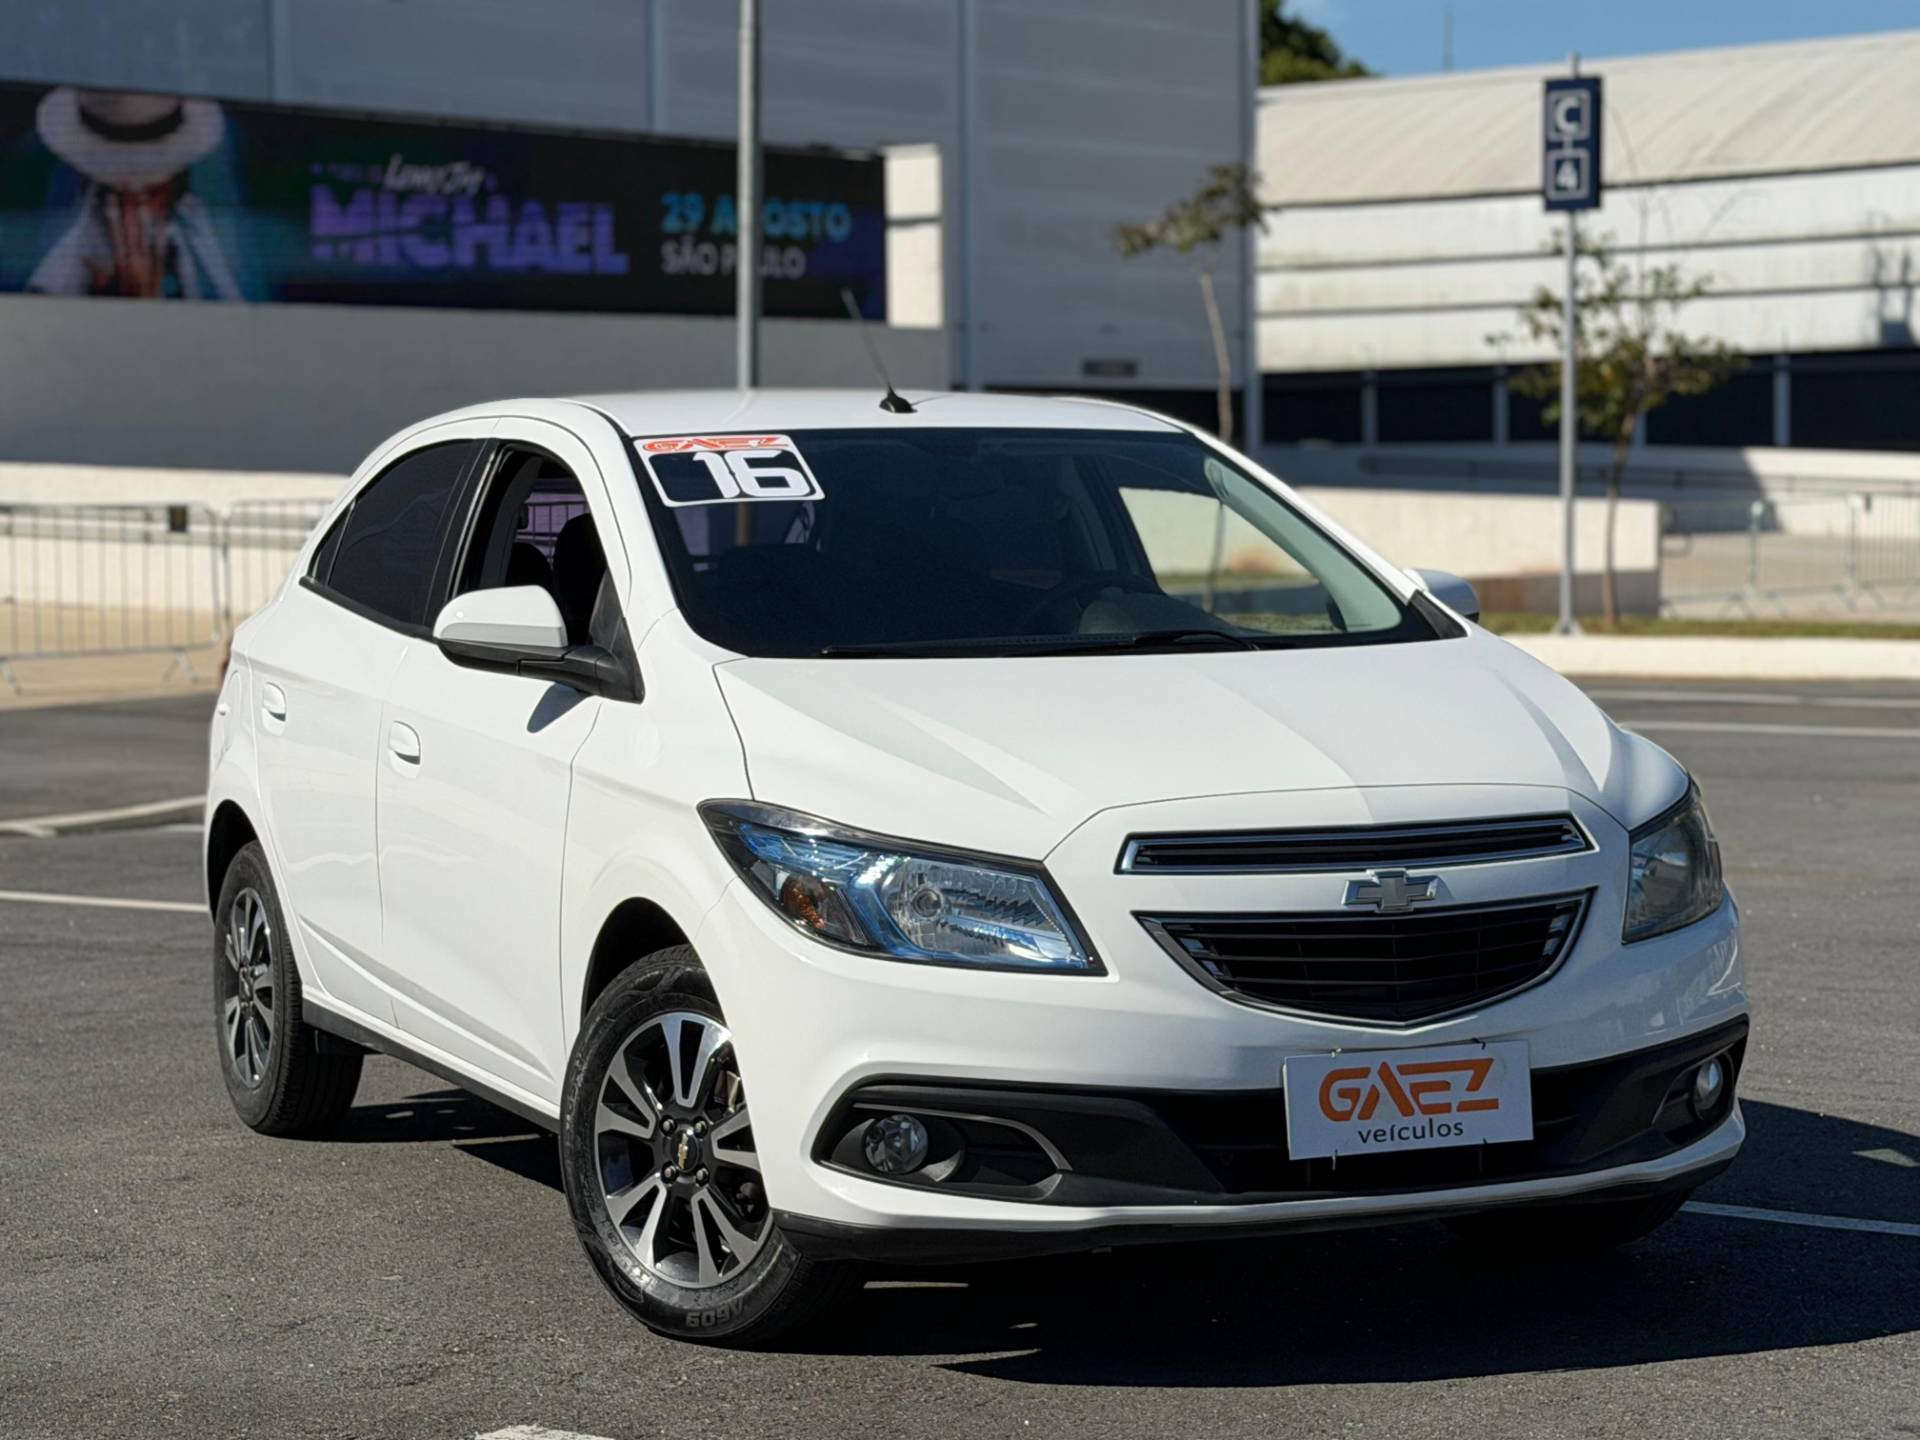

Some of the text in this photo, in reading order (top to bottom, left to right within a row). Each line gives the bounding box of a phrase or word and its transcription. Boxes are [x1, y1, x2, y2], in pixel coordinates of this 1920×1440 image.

[1555, 96, 1581, 134] C
[310, 182, 631, 276] MICHAEL
[659, 191, 853, 244] 29 AOSTO
[659, 233, 719, 277] SÃO
[692, 449, 812, 499] 16
[1318, 1057, 1500, 1123] GAEZ
[1357, 1117, 1465, 1145] veículos
